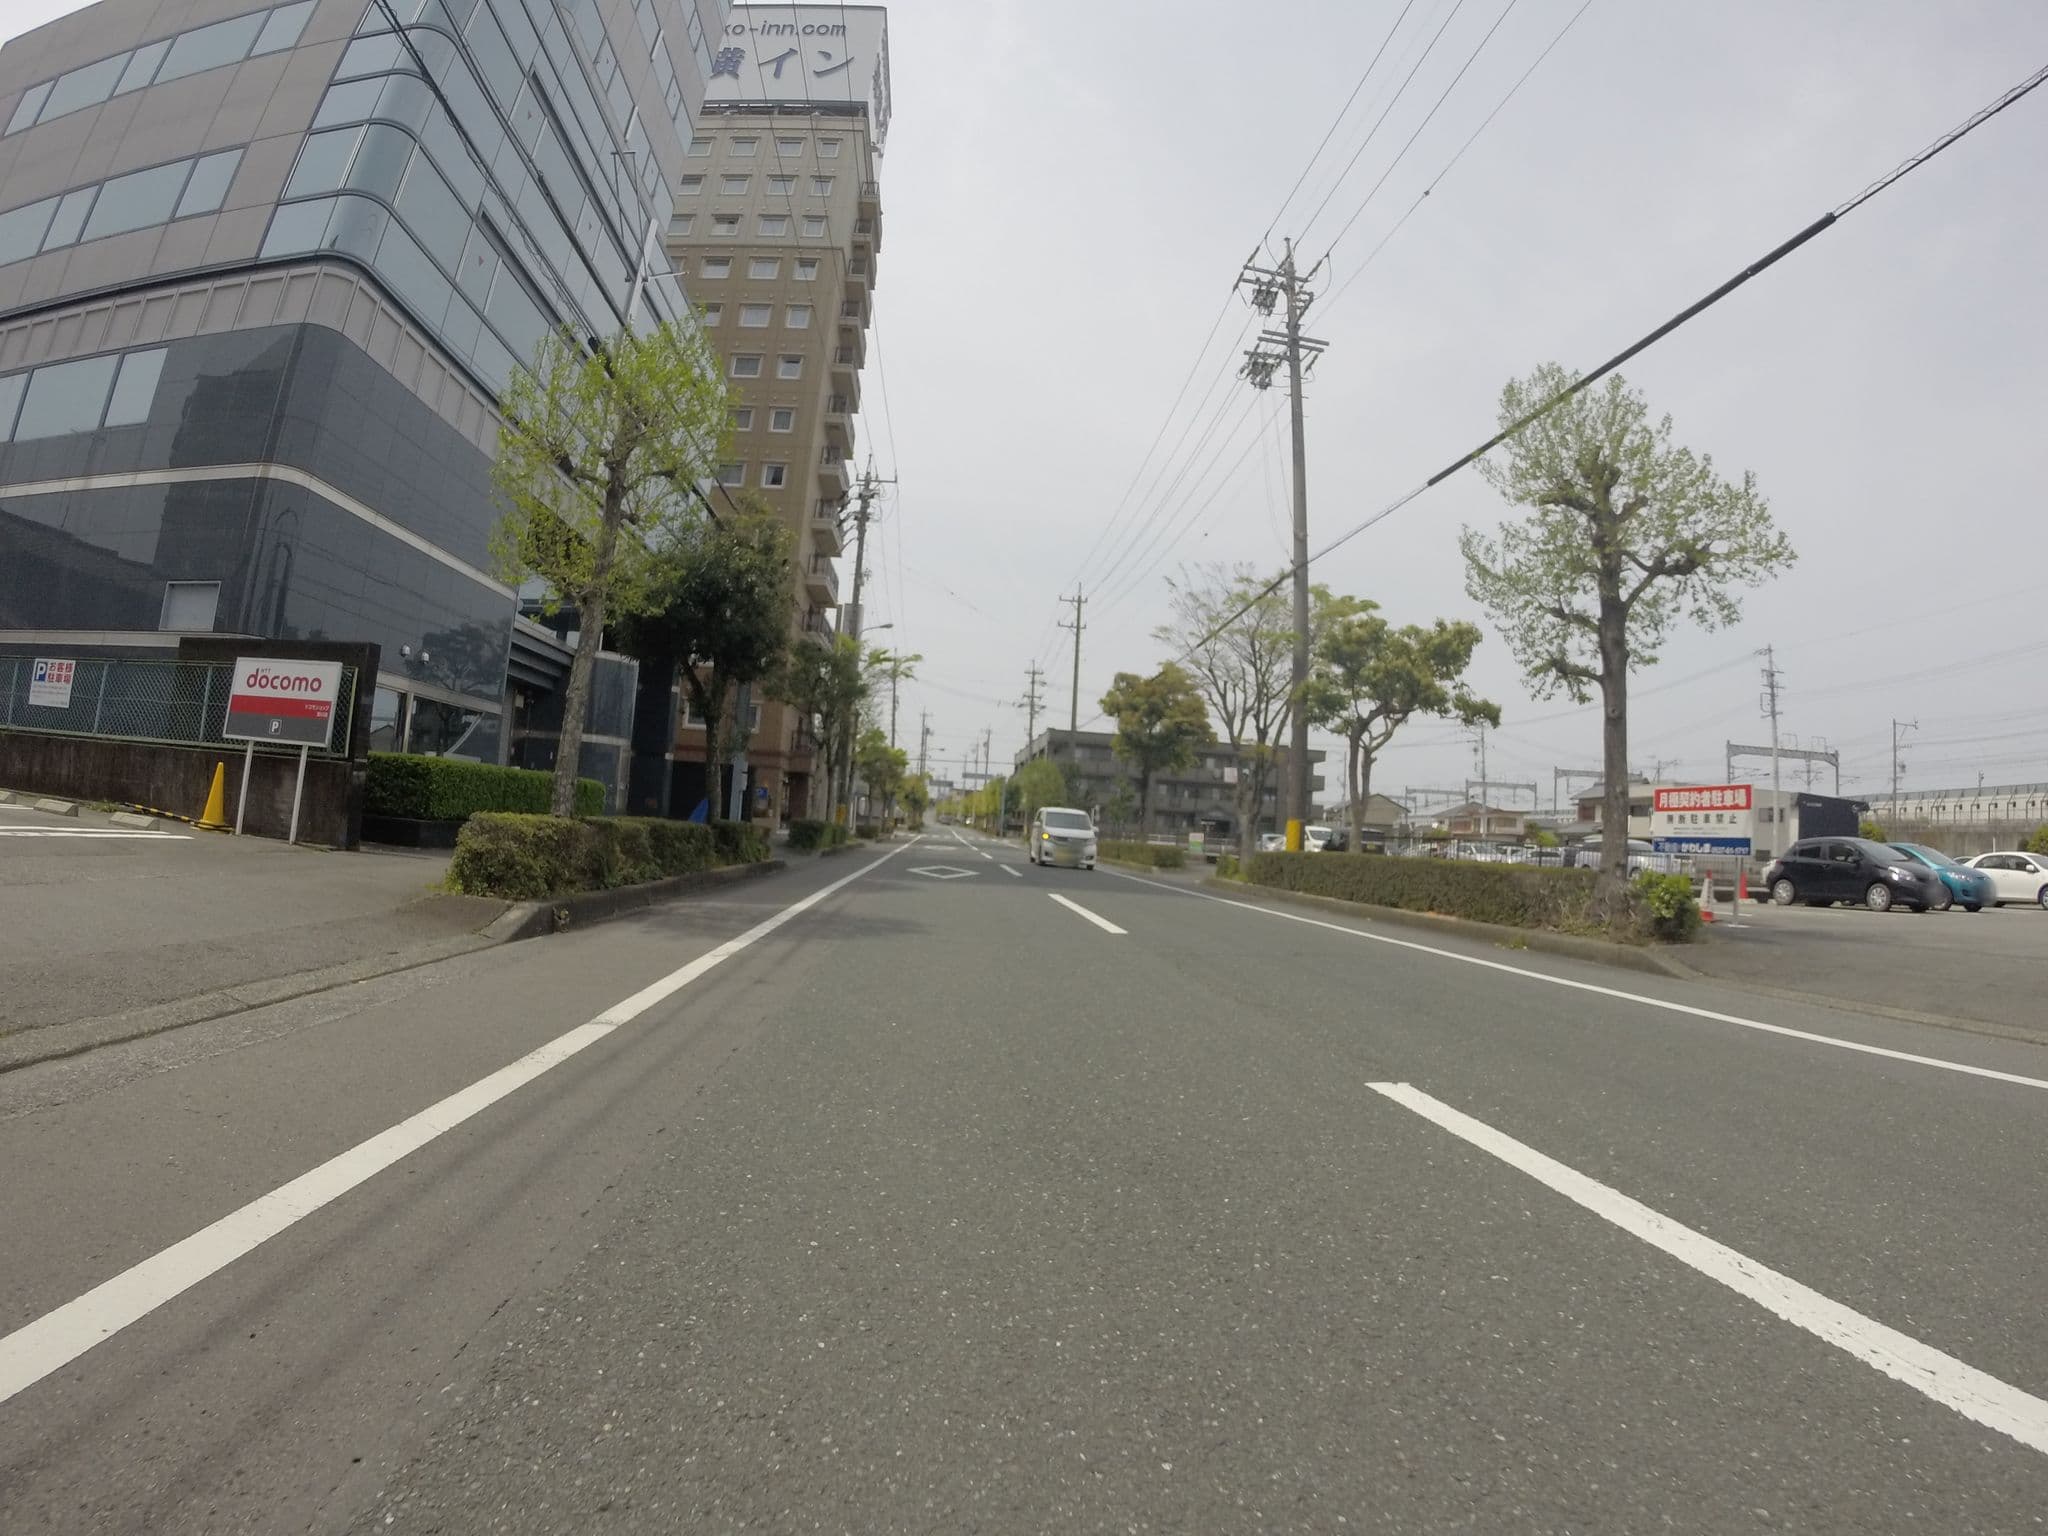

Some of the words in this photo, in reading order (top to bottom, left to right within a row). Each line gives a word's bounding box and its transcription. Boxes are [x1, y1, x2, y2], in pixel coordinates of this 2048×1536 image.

[49, 662, 74, 673] お客様
[47, 673, 71, 684] 駐車場
[246, 668, 322, 692] docomo
[271, 721, 280, 732] P
[1659, 788, 1747, 809] 月極契約者駐車場
